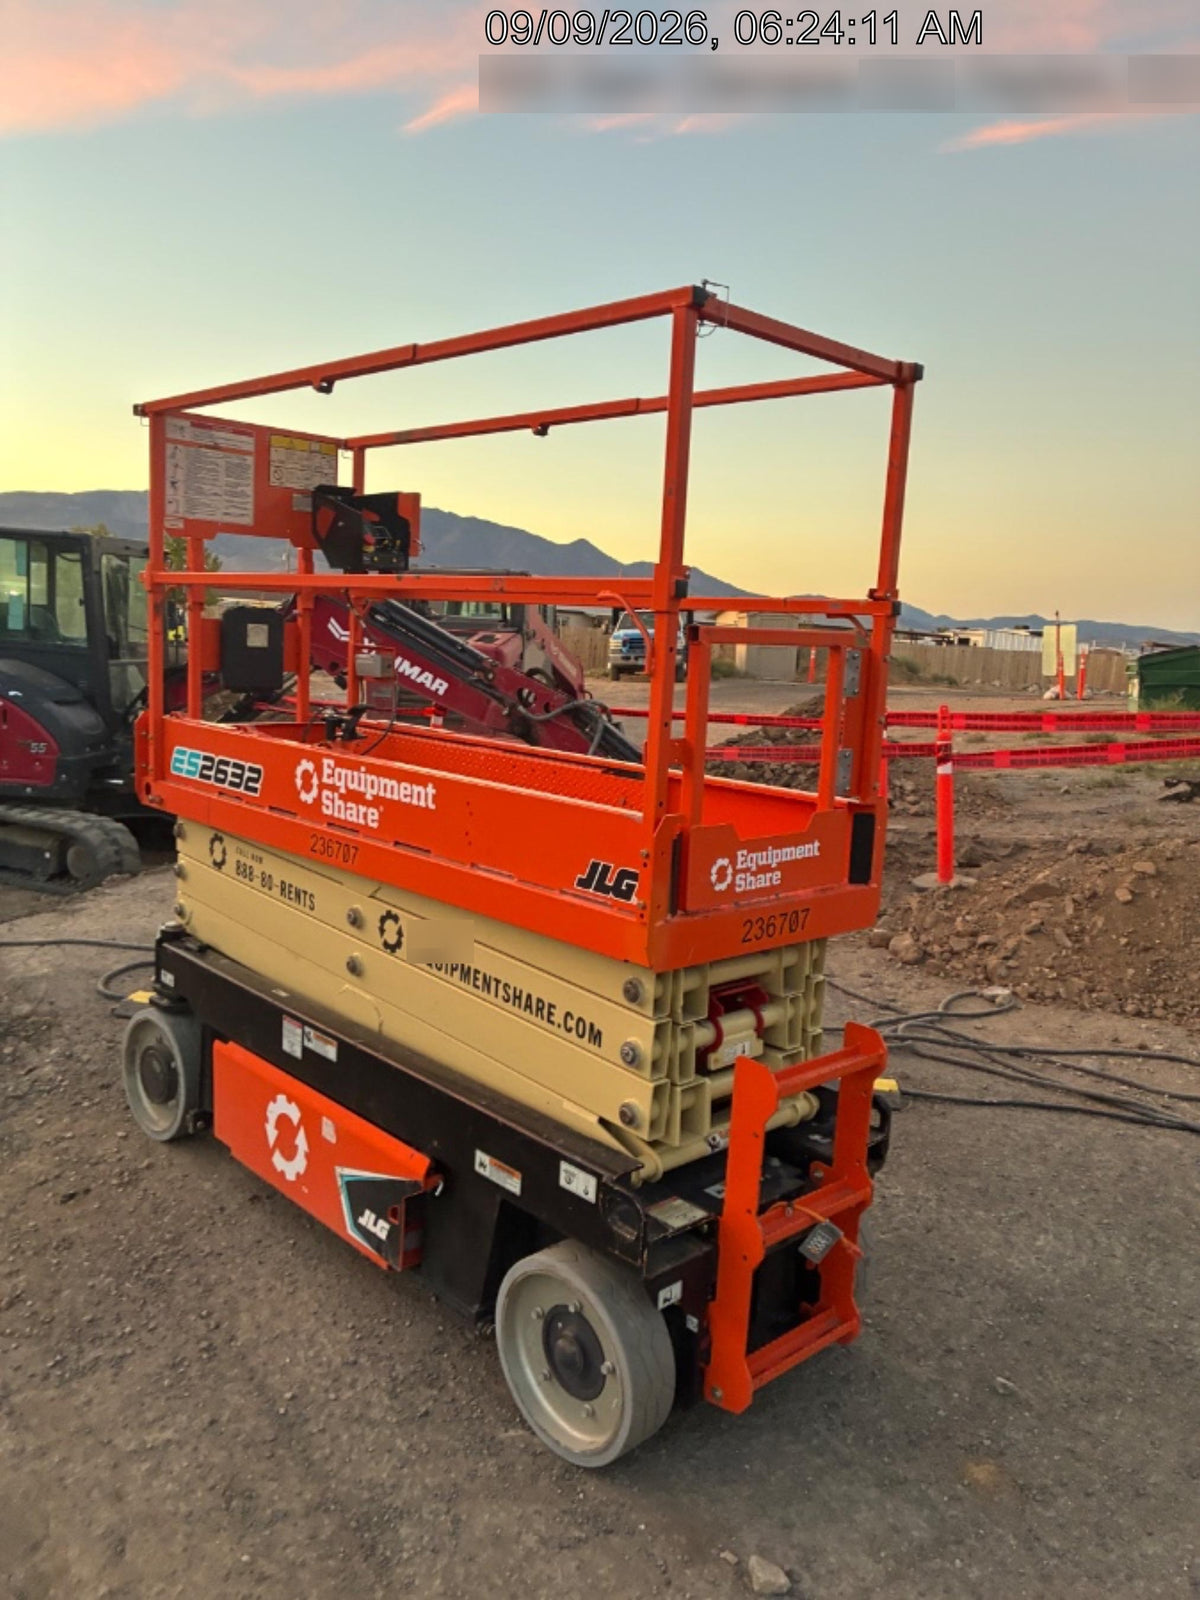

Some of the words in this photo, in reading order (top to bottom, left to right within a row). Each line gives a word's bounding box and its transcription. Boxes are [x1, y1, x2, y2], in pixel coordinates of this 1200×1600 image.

[171, 746, 263, 797] ES2632
[321, 758, 437, 810] Equipment
[321, 790, 380, 829] Share
[309, 833, 359, 866] 236707
[735, 840, 821, 871] Equipment
[235, 859, 316, 912] 888-80-RENTS
[574, 858, 639, 904] JLG
[735, 870, 782, 893] Share
[741, 907, 811, 944] 236707
[358, 1208, 391, 1241] JLG
